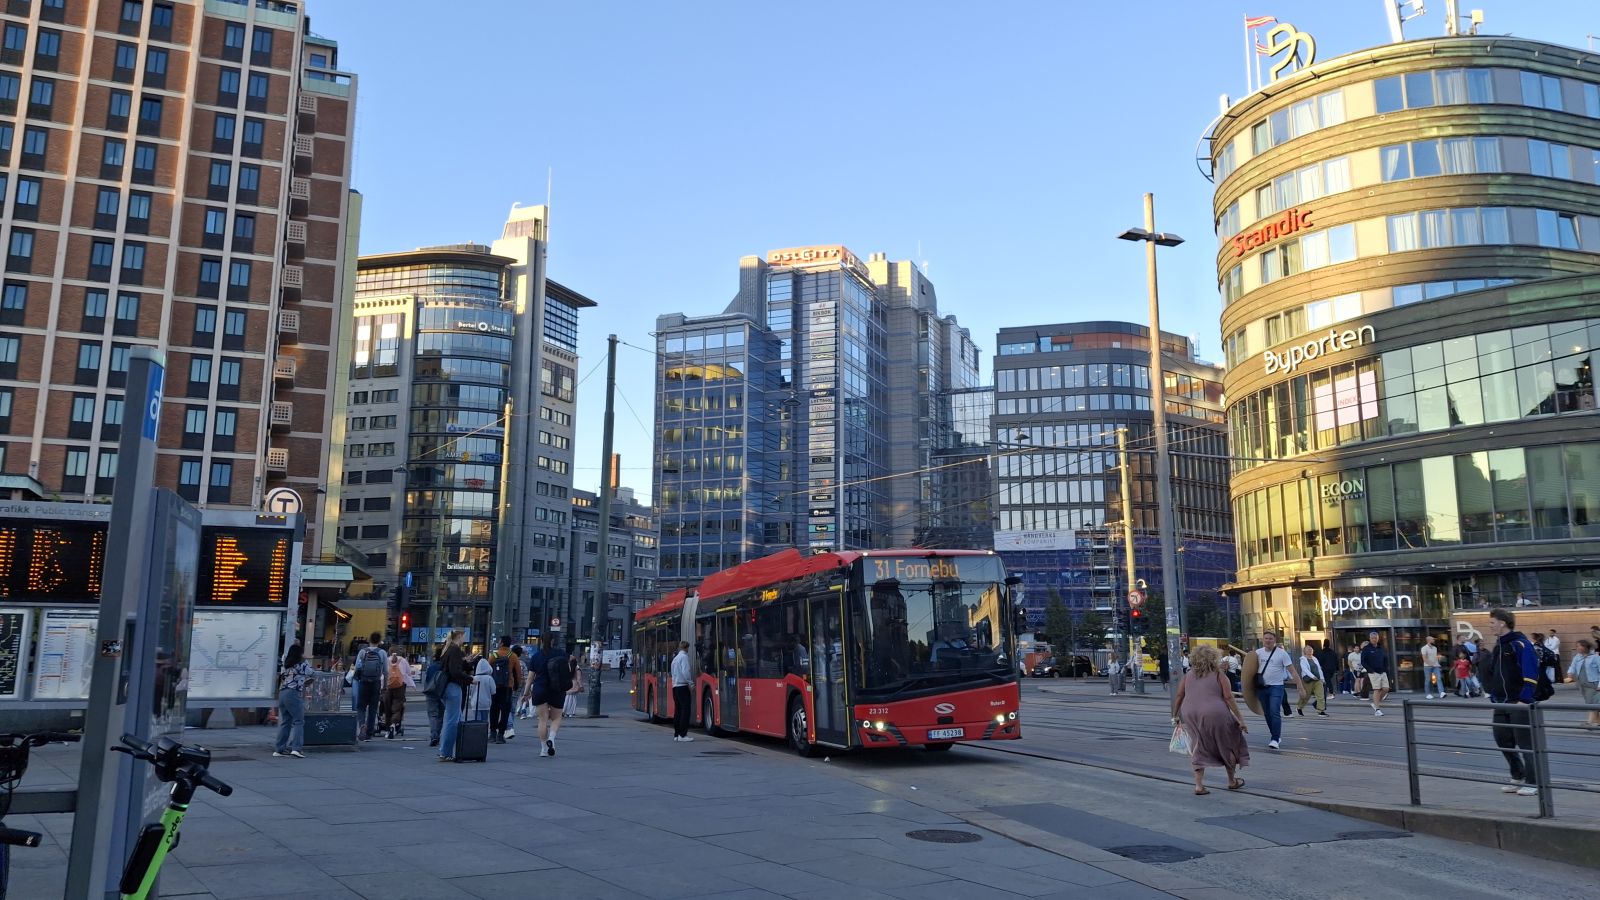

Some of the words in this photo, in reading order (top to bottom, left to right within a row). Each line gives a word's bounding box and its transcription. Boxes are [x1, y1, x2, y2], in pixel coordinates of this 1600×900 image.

[1231, 208, 1313, 258] Scandic
[458, 321, 477, 330] Bertel
[1263, 324, 1376, 375] Byporten
[35, 505, 67, 516] Public
[68, 508, 110, 519] transpor
[277, 497, 294, 512] T
[874, 559, 890, 579] 31
[895, 559, 959, 579] Fornebu
[1322, 592, 1413, 615] Byporten
[943, 729, 962, 737] 45238
[165, 815, 181, 844] ryde
